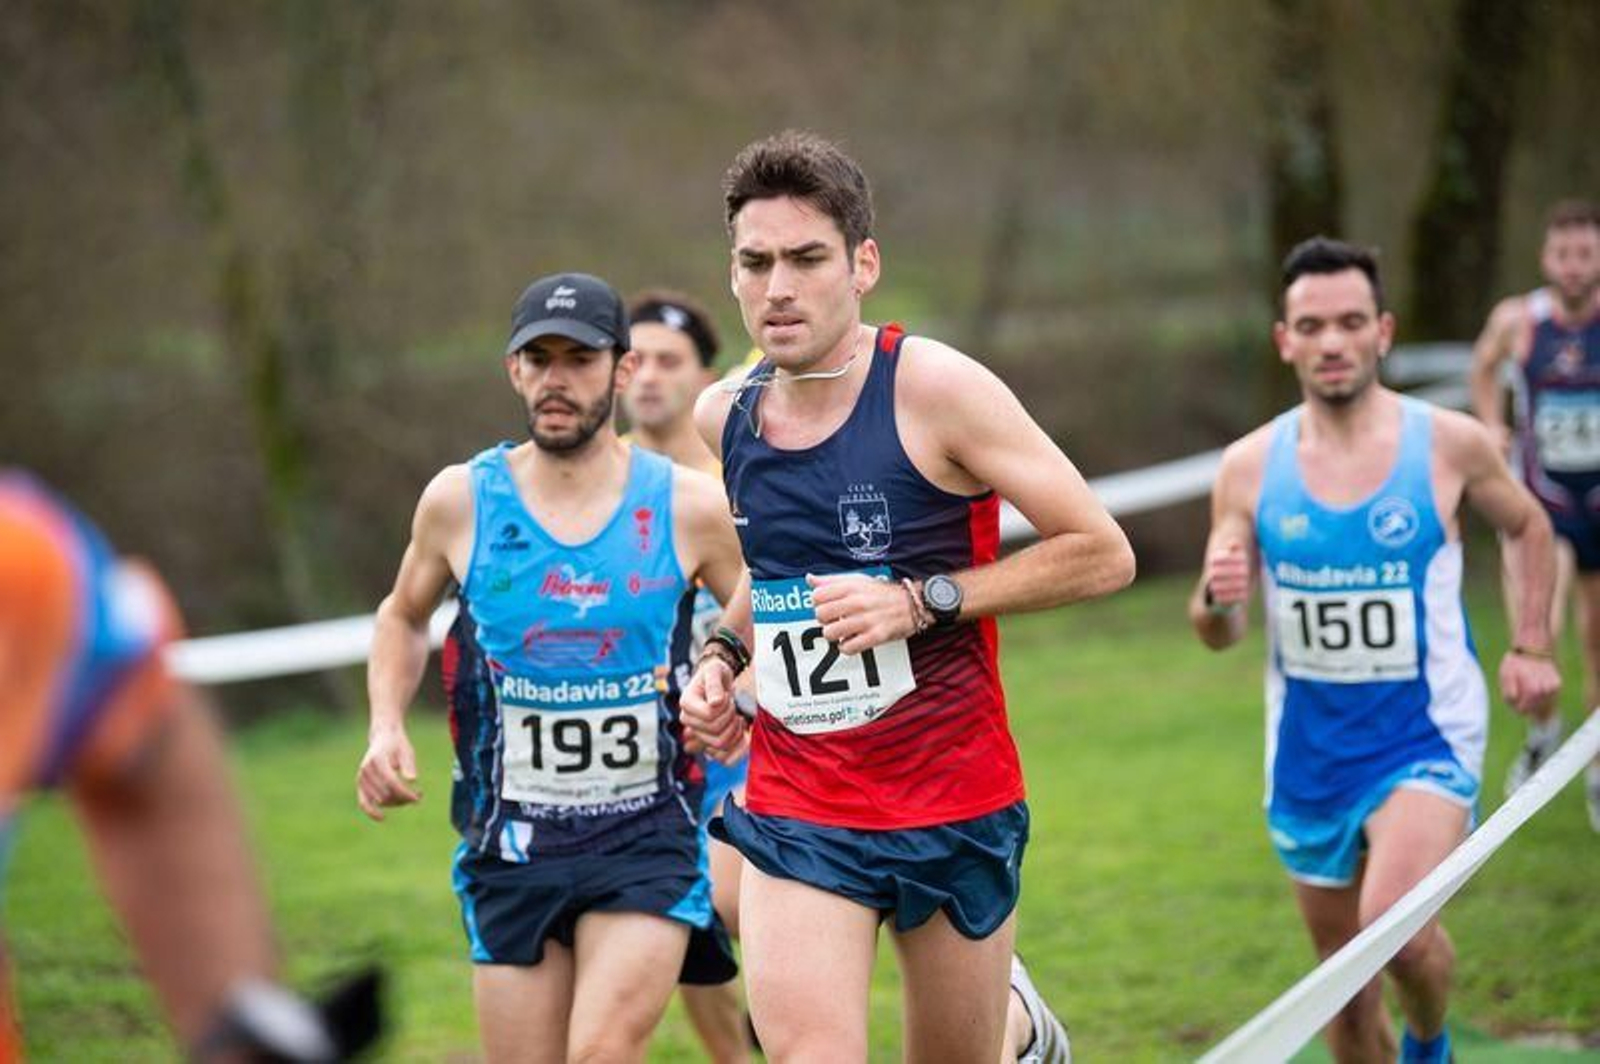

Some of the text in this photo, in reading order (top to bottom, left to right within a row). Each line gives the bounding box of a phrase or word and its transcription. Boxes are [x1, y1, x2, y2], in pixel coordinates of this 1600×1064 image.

[1292, 600, 1396, 650] 150
[502, 676, 619, 702] Ribadavia
[773, 627, 881, 697] 121
[521, 714, 639, 774] 193
